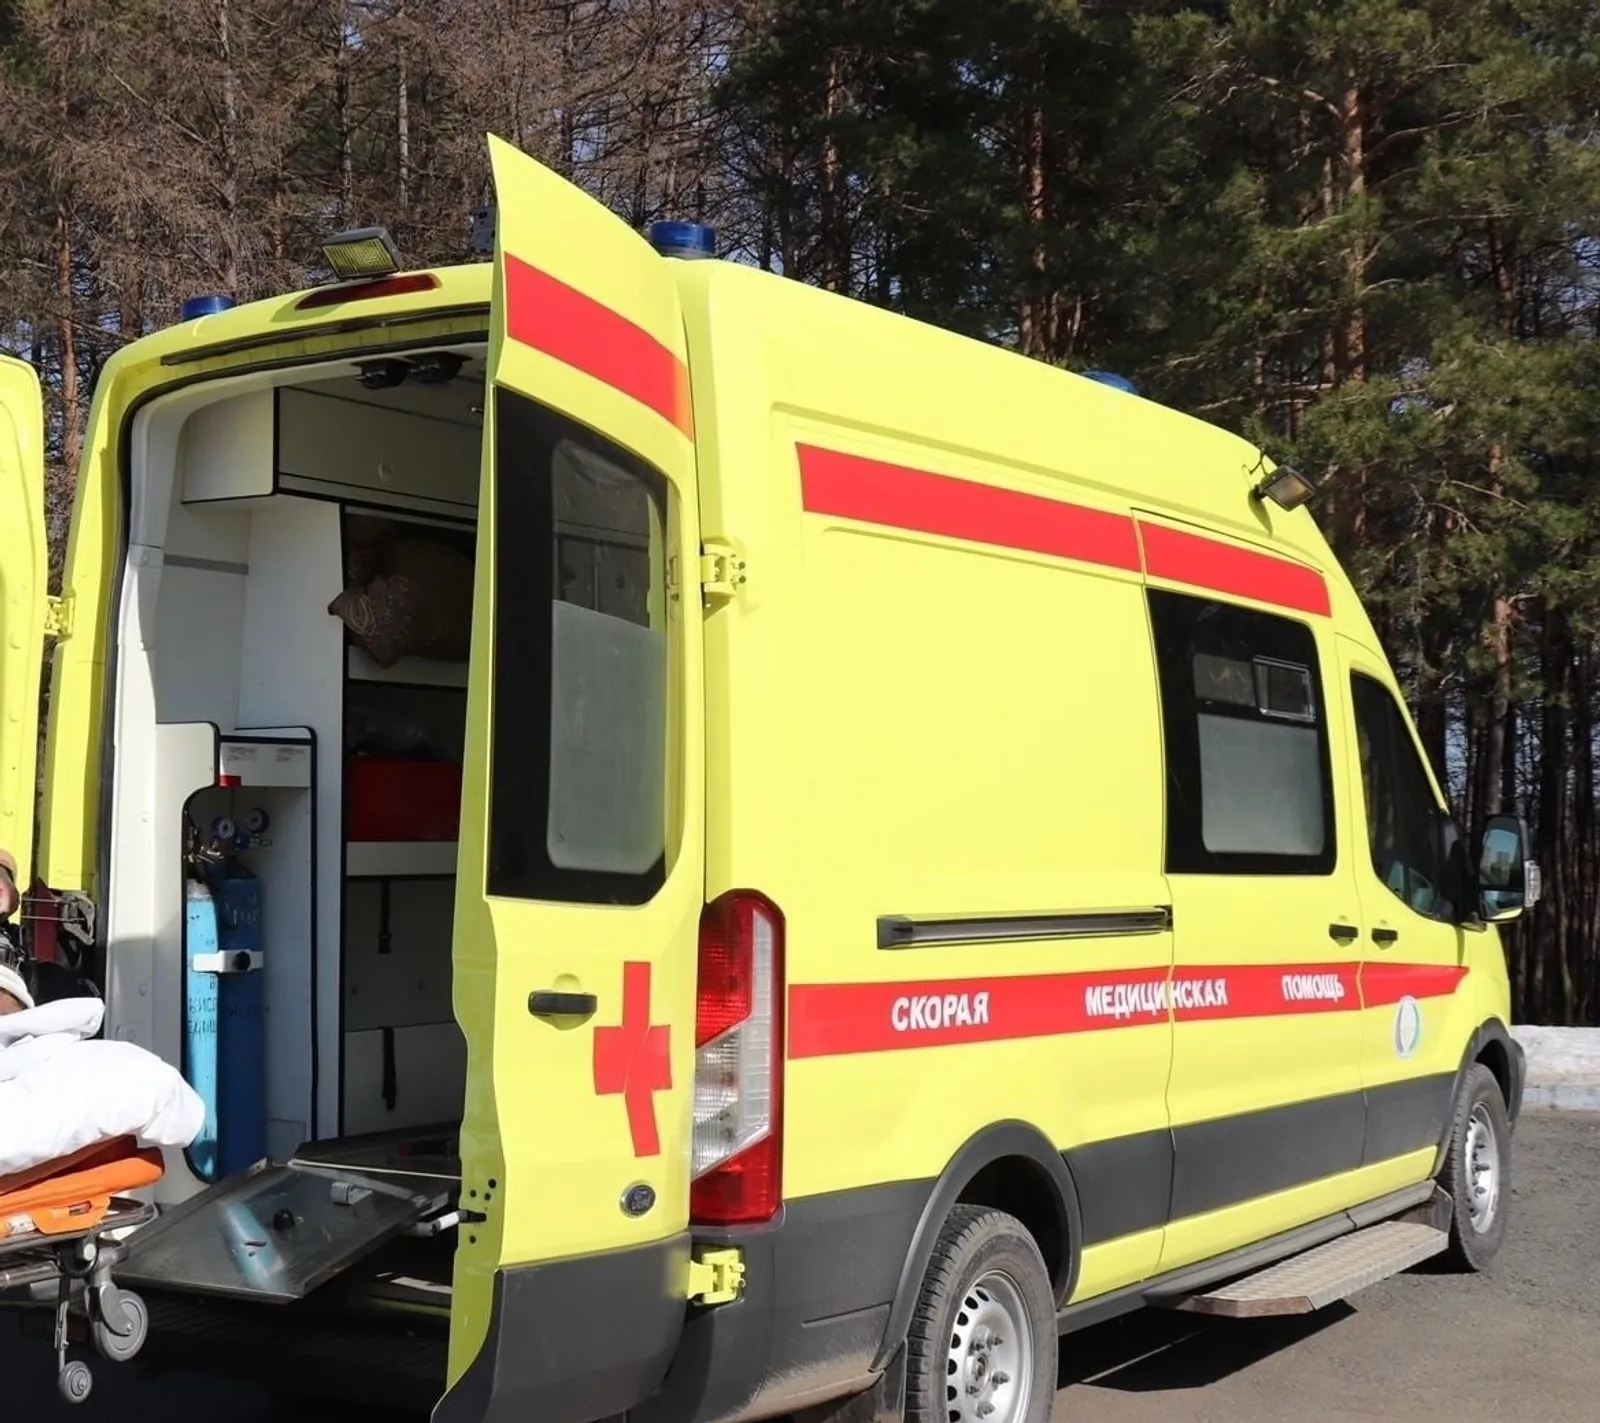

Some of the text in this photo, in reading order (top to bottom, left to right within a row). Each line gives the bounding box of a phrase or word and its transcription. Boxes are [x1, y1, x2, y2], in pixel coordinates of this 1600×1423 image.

[891, 973, 1345, 1032] СКОРАЯ МЕДИЦИНСКАЯ ПОМОЩЬ
